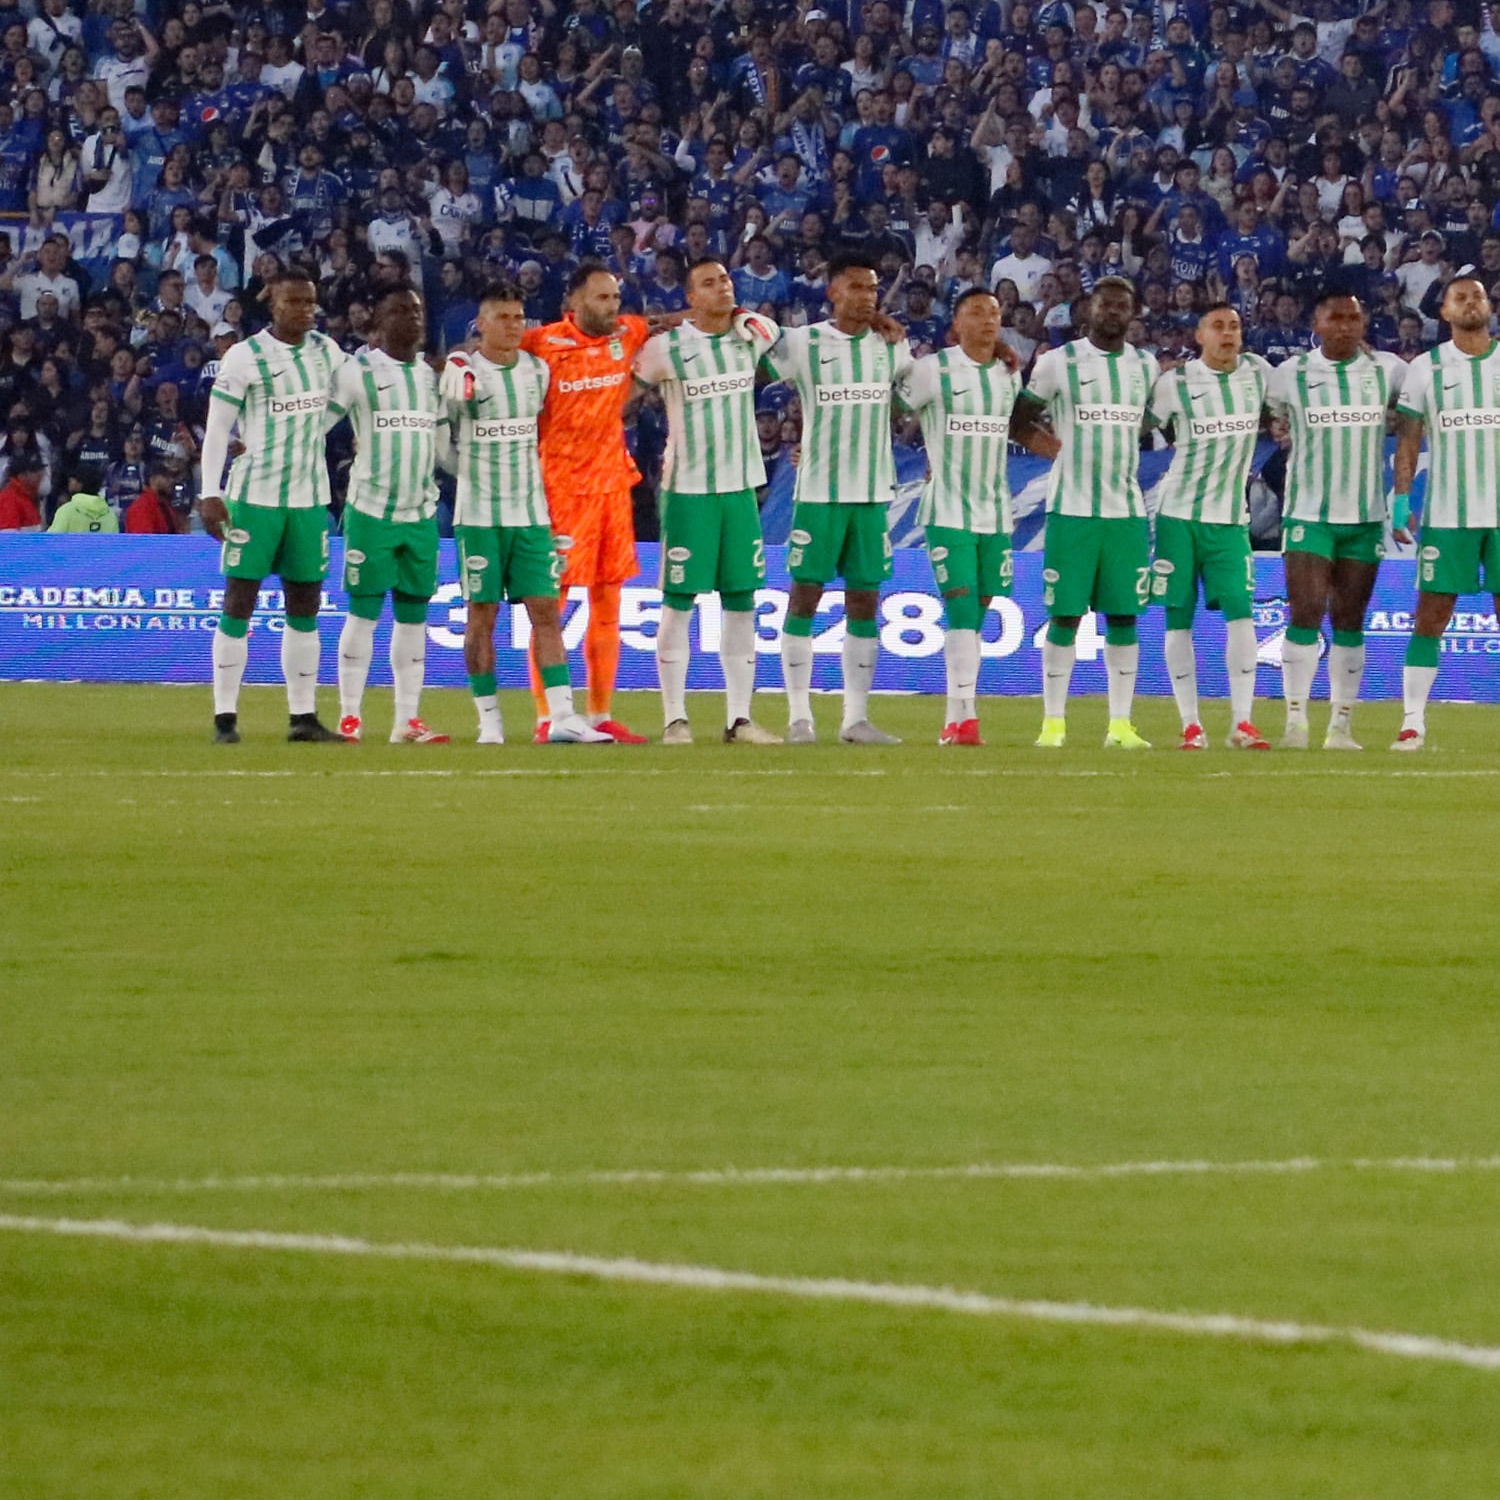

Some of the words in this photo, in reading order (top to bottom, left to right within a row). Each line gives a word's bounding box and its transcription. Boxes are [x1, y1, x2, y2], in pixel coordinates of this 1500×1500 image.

[1308, 410, 1381, 425] betsson
[0, 586, 146, 608] CADEMIA
[154, 588, 194, 610] DE
[22, 614, 220, 632] MILLONARIO
